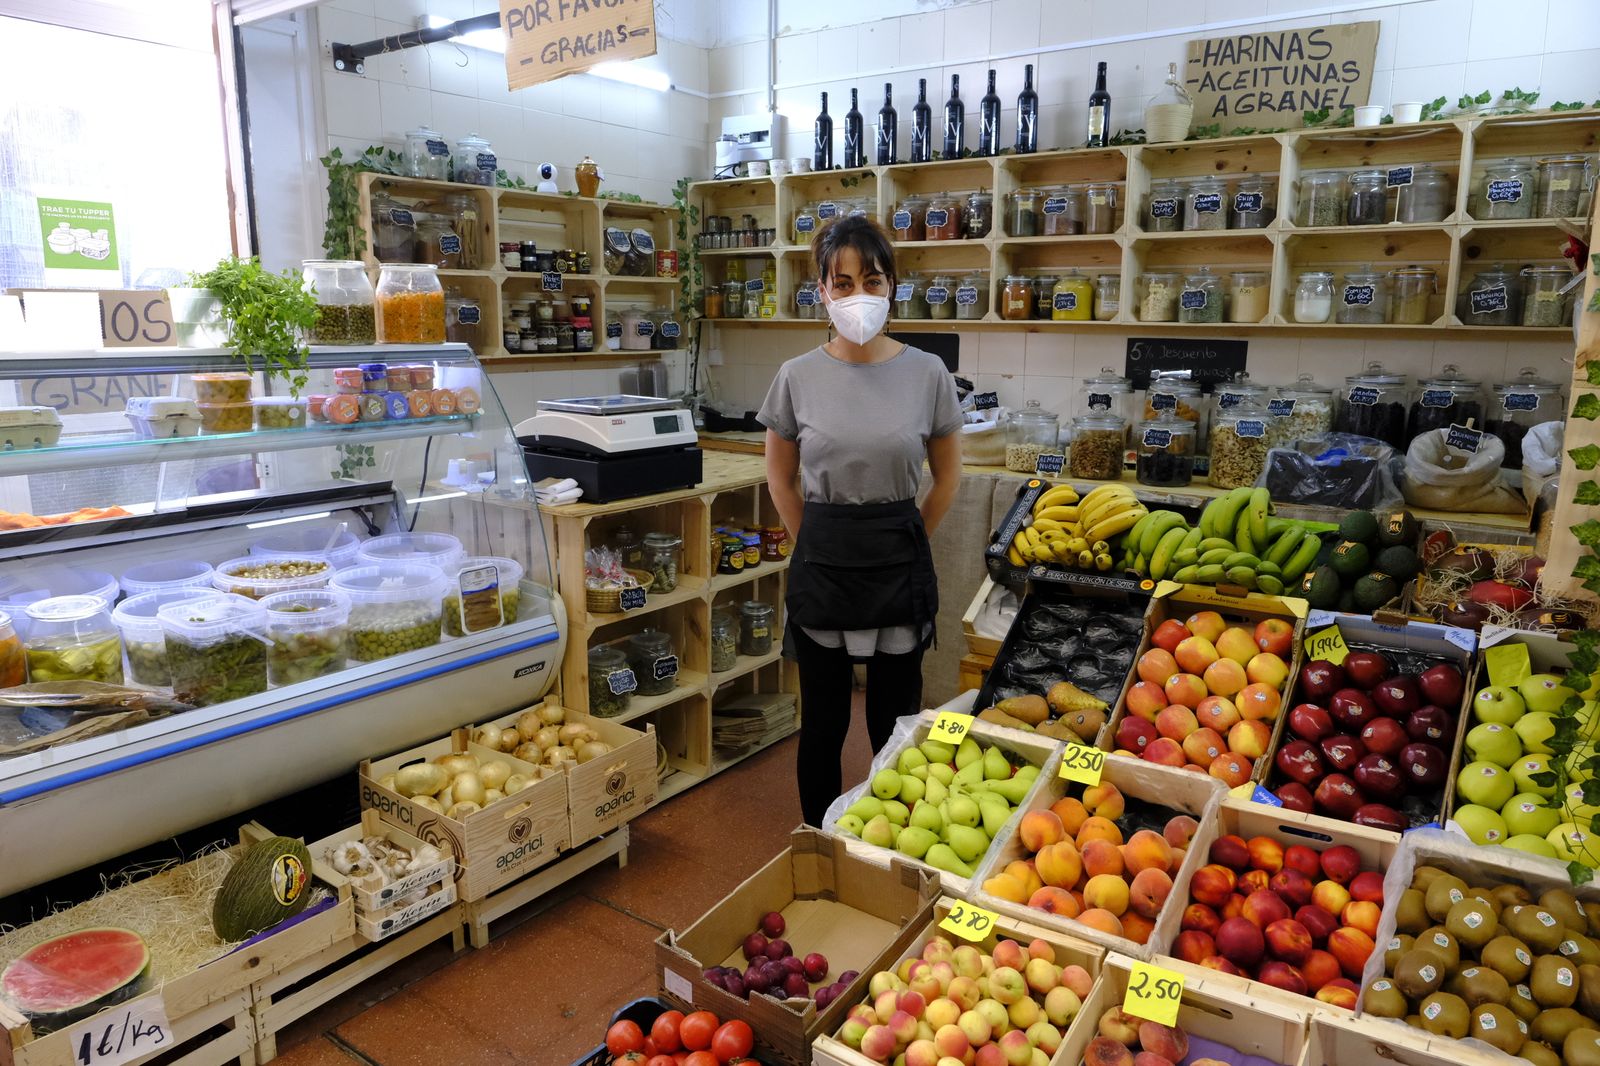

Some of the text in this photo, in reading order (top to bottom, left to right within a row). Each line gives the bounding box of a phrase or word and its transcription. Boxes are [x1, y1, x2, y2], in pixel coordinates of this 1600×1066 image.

[506, 0, 552, 39] POR
[78, 208, 110, 217] TUPPER
[1046, 570, 1068, 580] PERAS
[1069, 573, 1077, 581] DE
[1106, 578, 1114, 586] DE
